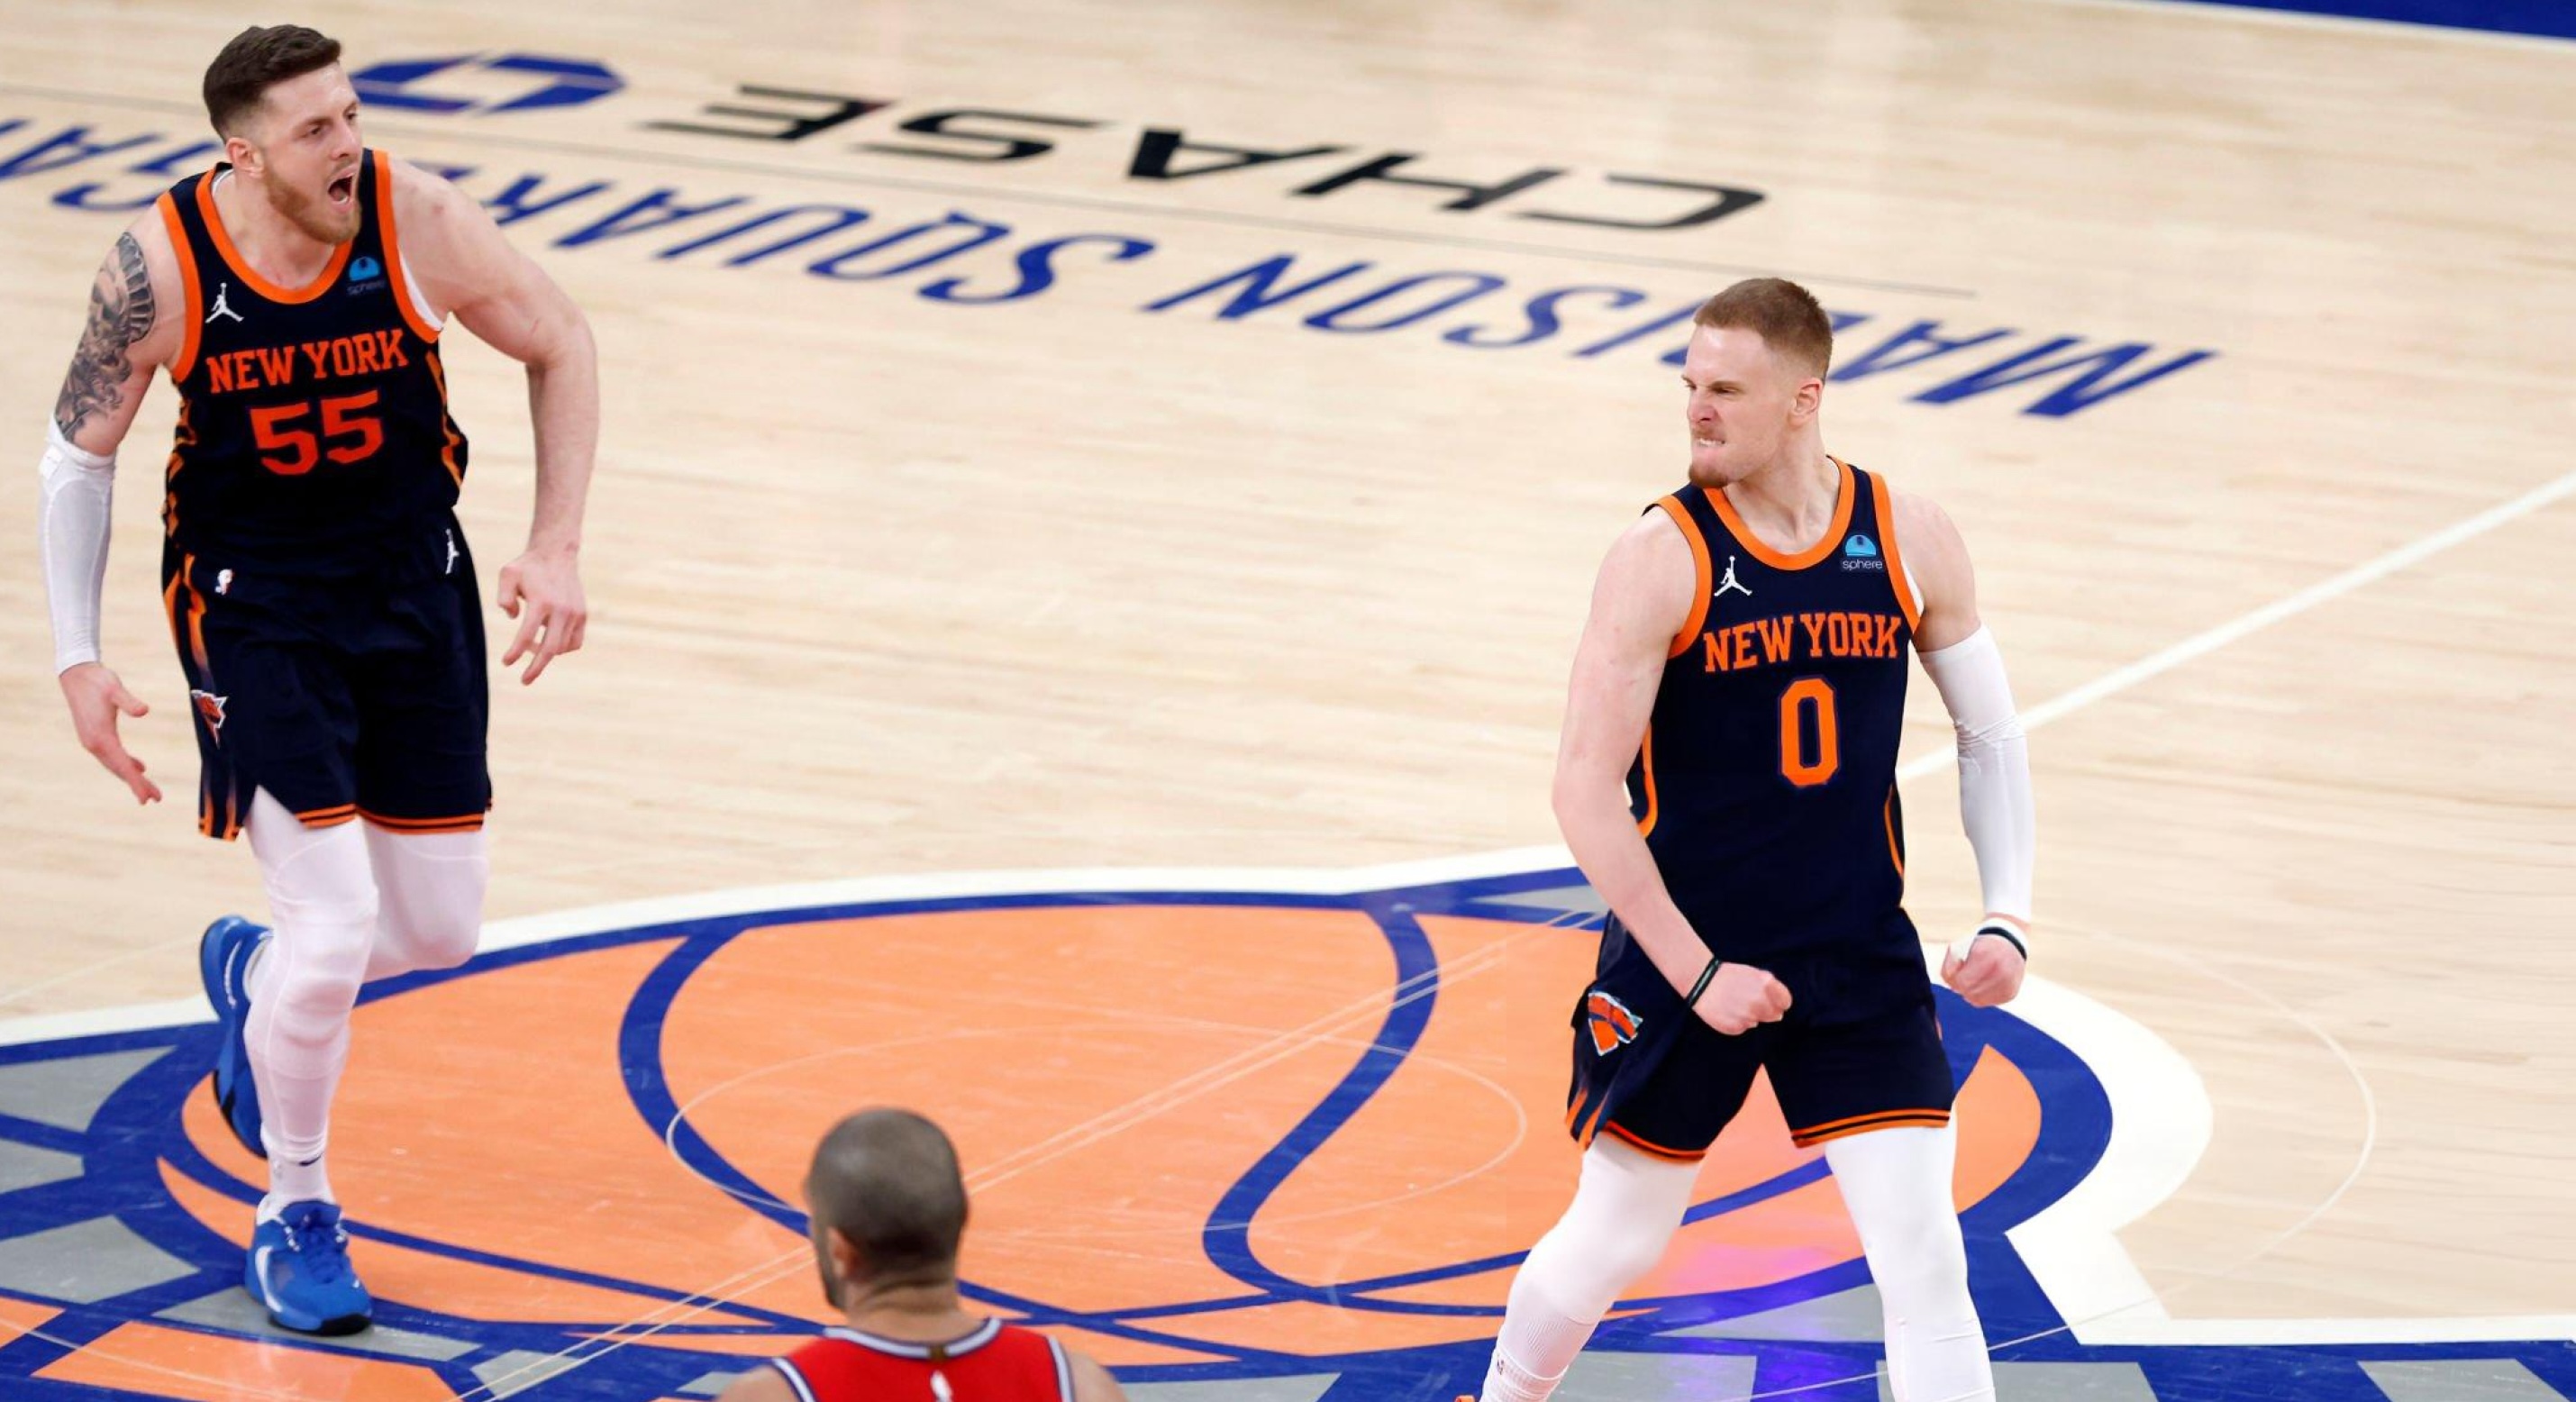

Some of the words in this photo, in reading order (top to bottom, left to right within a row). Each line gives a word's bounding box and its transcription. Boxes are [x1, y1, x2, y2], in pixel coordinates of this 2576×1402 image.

[638, 84, 1769, 229] CHASE
[406, 159, 1159, 305] SQUAR
[205, 345, 296, 394] NEW
[301, 328, 409, 378] YORK
[1144, 253, 2219, 419] MAISON
[250, 389, 384, 476] 55
[1843, 559, 1883, 571] sphere
[1703, 615, 1794, 673] NEW
[1799, 612, 1902, 659] YORK
[1780, 678, 1839, 787] 0
